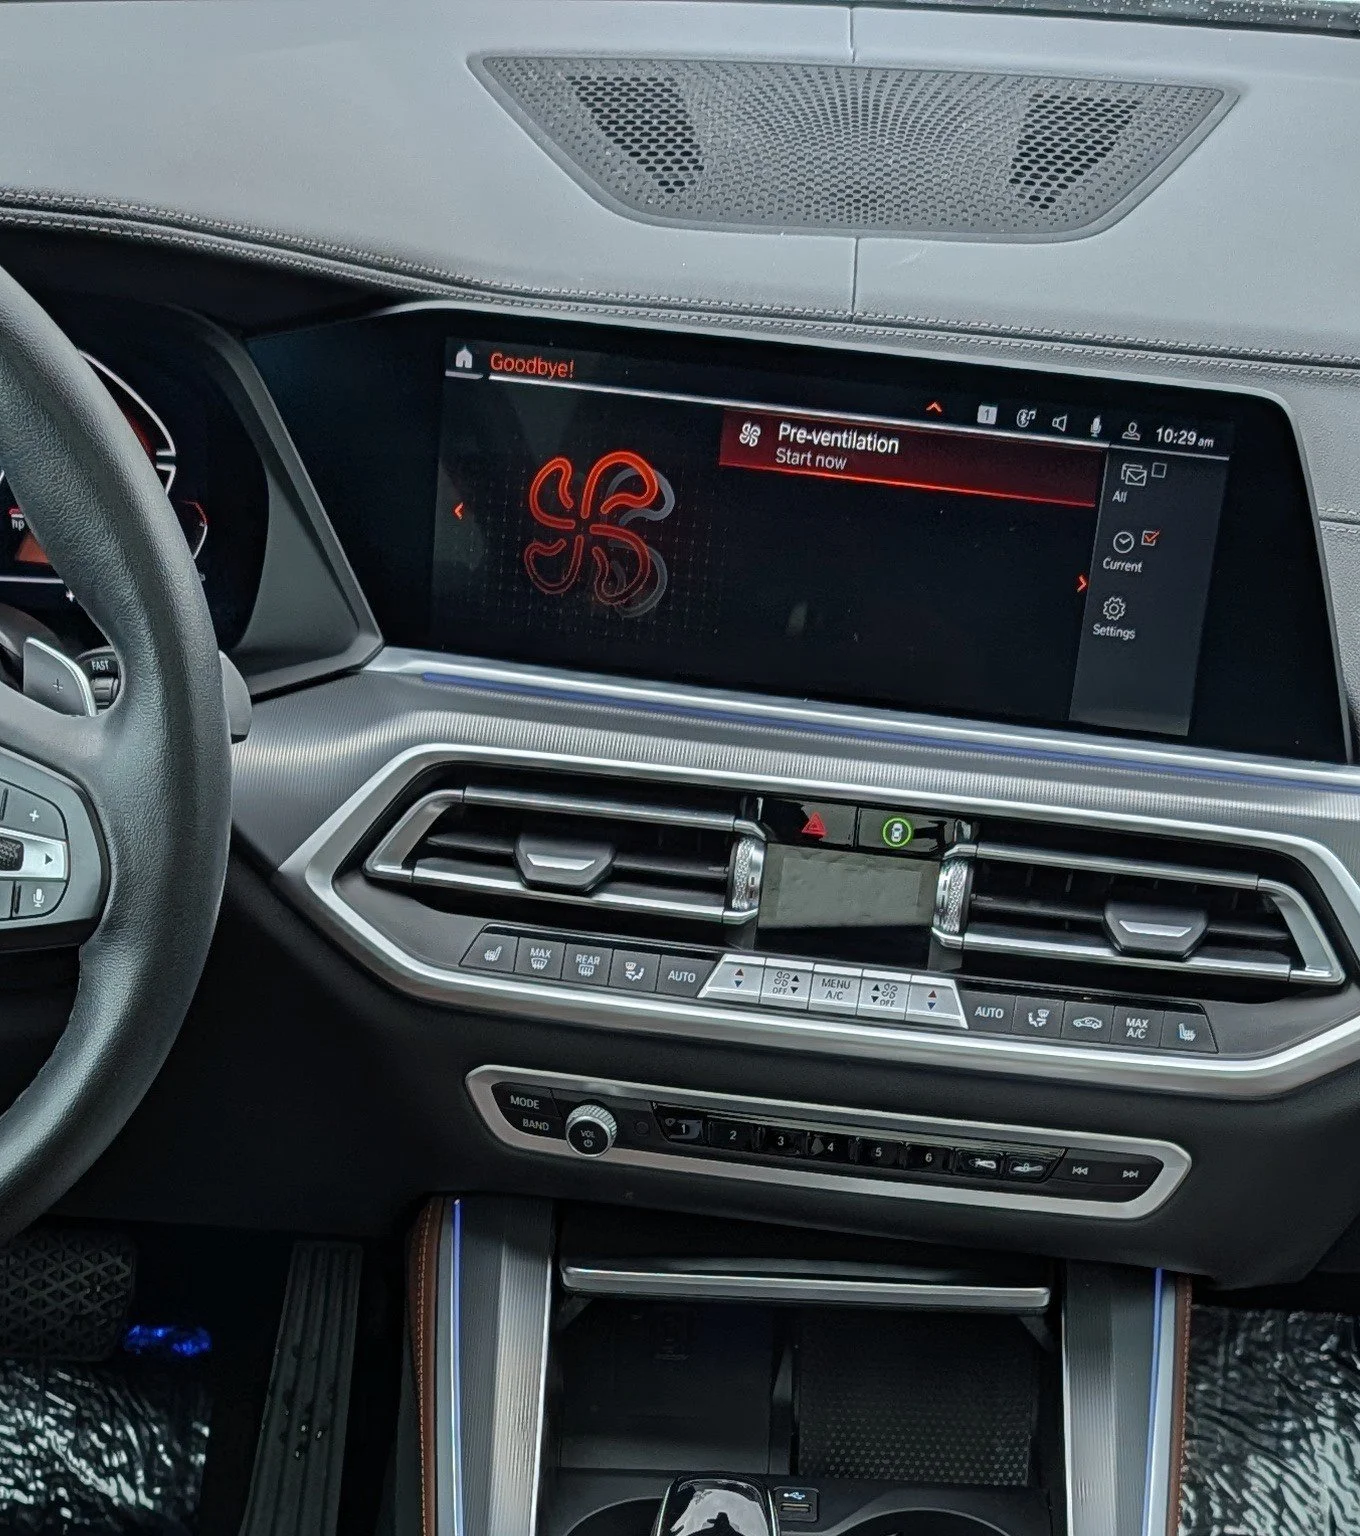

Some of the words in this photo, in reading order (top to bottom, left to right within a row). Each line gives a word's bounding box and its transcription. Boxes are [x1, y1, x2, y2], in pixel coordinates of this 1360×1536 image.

[490, 352, 575, 380] Goodbye!
[778, 421, 900, 455] Pre-ventilation
[1155, 426, 1197, 447] 10:29
[1198, 437, 1214, 449] am
[775, 447, 812, 467] Start
[815, 454, 848, 471] now
[1112, 488, 1128, 503] All
[1102, 556, 1143, 574] Current
[1092, 623, 1136, 641] Settings
[91, 660, 109, 671] FAST
[529, 946, 552, 959] MAX
[575, 954, 600, 967] REAR
[667, 970, 696, 984] AUTO
[821, 977, 852, 991] MENU
[772, 986, 788, 996] OFF
[825, 989, 844, 1002] A/C
[974, 1005, 1004, 1020] AUTO
[1125, 1016, 1149, 1030] MAX
[1126, 1028, 1146, 1041] A/C
[510, 1094, 540, 1110] MODE
[522, 1117, 550, 1133] BAND
[680, 1122, 687, 1134] 1
[580, 1129, 596, 1139] VOL
[729, 1130, 737, 1141] 2
[777, 1135, 785, 1147] 3
[827, 1142, 834, 1152] 4
[875, 1147, 882, 1158] 5
[925, 1152, 932, 1163] 6
